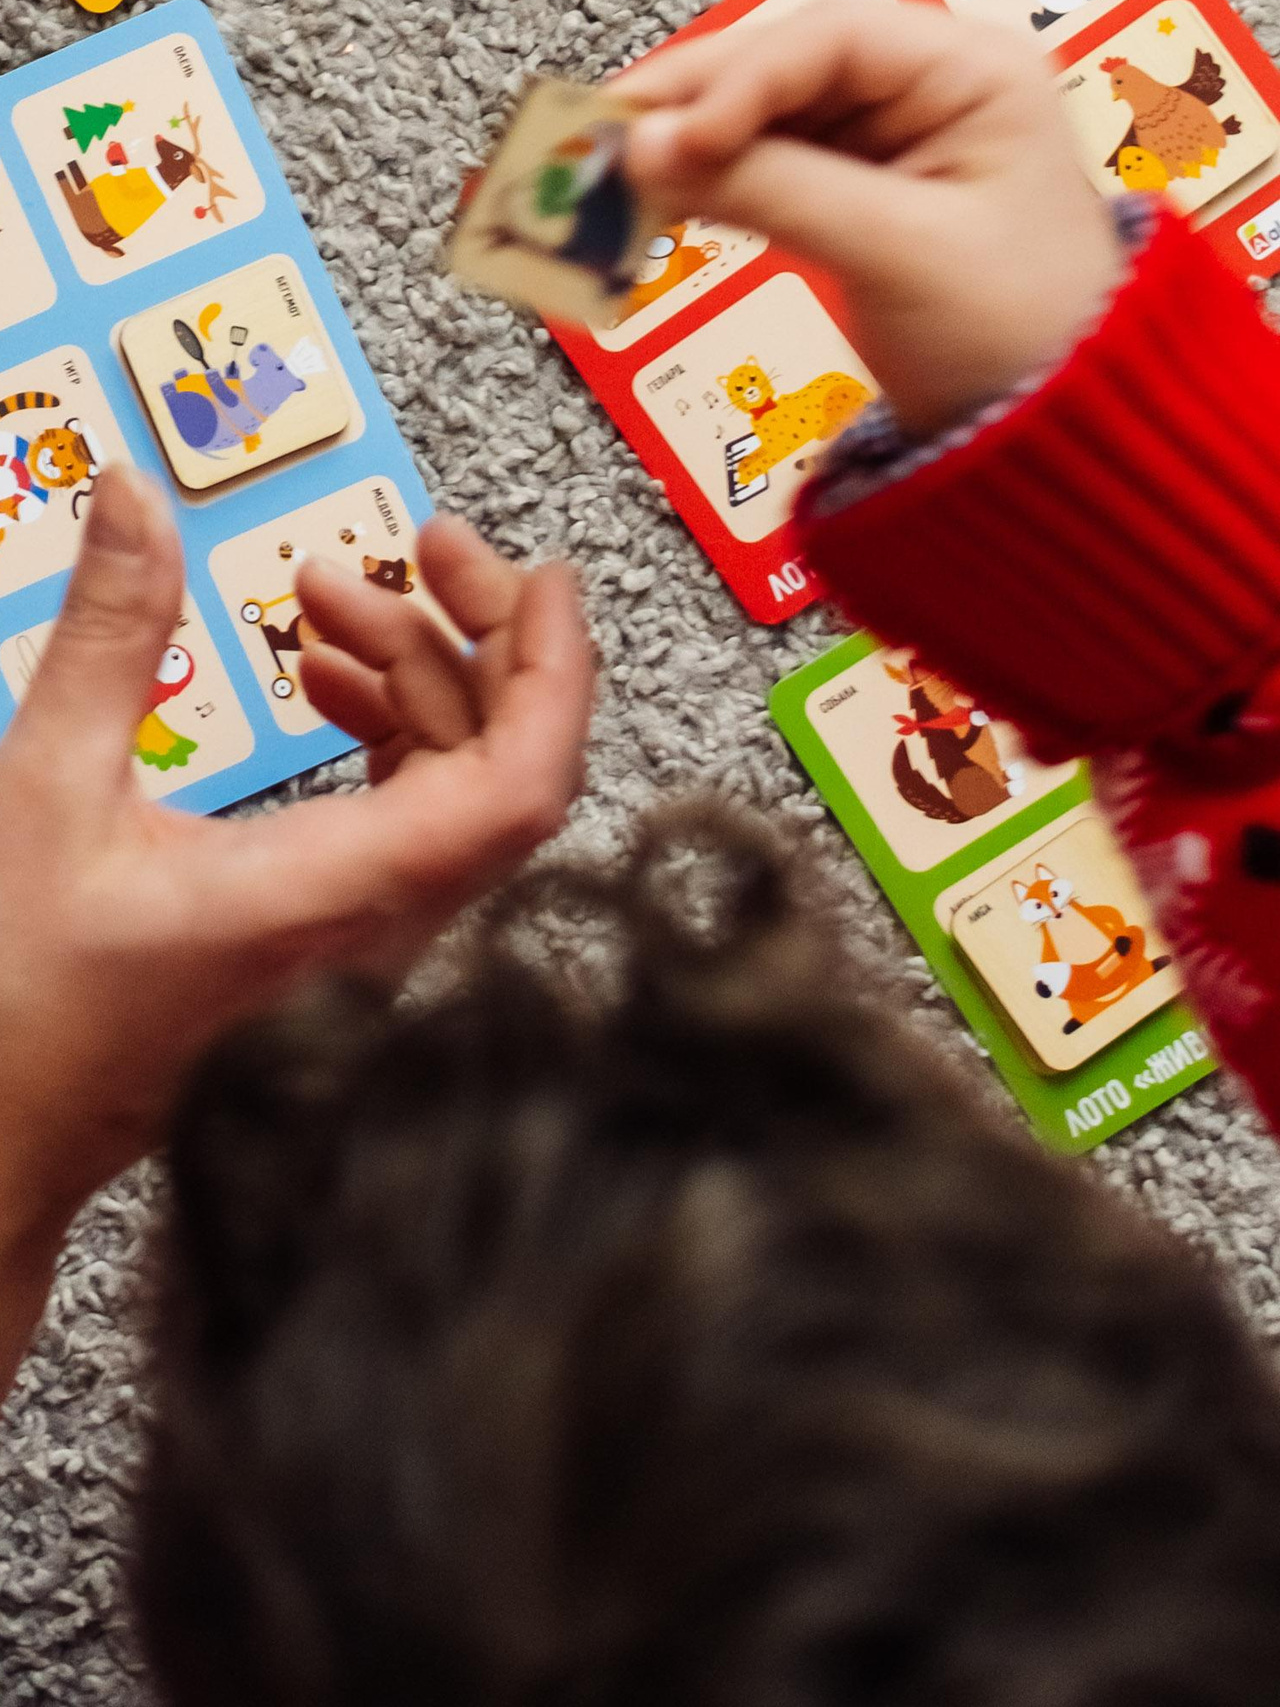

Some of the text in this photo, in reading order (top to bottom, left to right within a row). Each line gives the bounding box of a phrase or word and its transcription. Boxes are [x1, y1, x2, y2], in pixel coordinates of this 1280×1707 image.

[173, 44, 194, 78] ОЛЕНЬ
[275, 275, 300, 317] БЕГЕМОТ
[62, 359, 81, 385] ТИГР
[372, 488, 399, 536] МЕДВЕДЬ
[1064, 1079, 1131, 1138] ЛОТО
